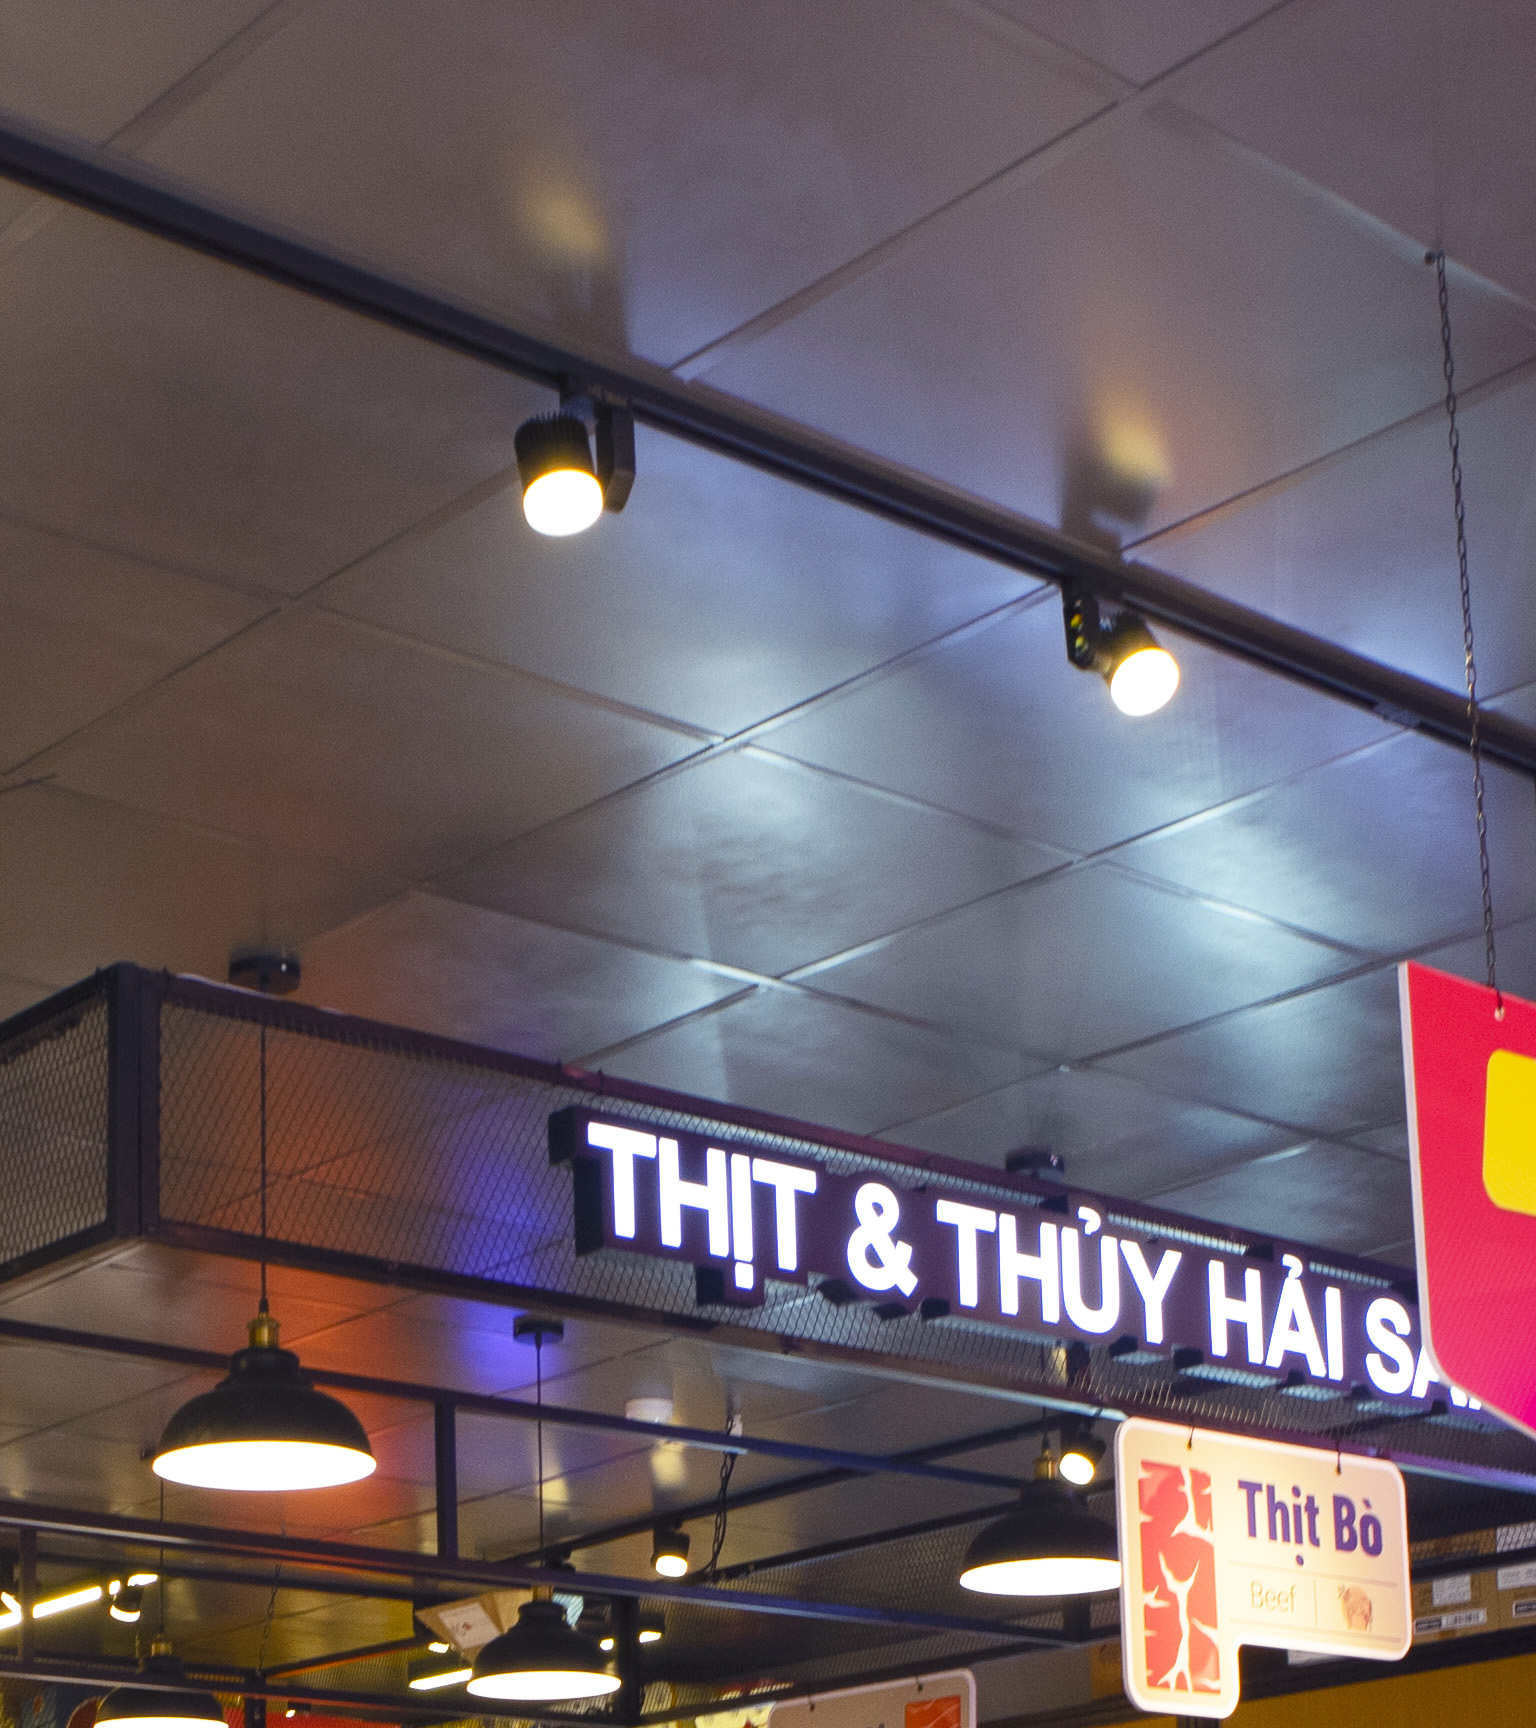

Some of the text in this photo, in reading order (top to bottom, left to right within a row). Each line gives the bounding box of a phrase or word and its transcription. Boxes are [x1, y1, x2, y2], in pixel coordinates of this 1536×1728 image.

[587, 1120, 817, 1291] THỊT
[846, 1180, 919, 1297] &
[936, 1198, 1184, 1345] THỦY
[1206, 1252, 1344, 1382] HẢI
[1237, 1478, 1383, 1567] Thịt Bò
[1250, 1579, 1297, 1614] Beef
